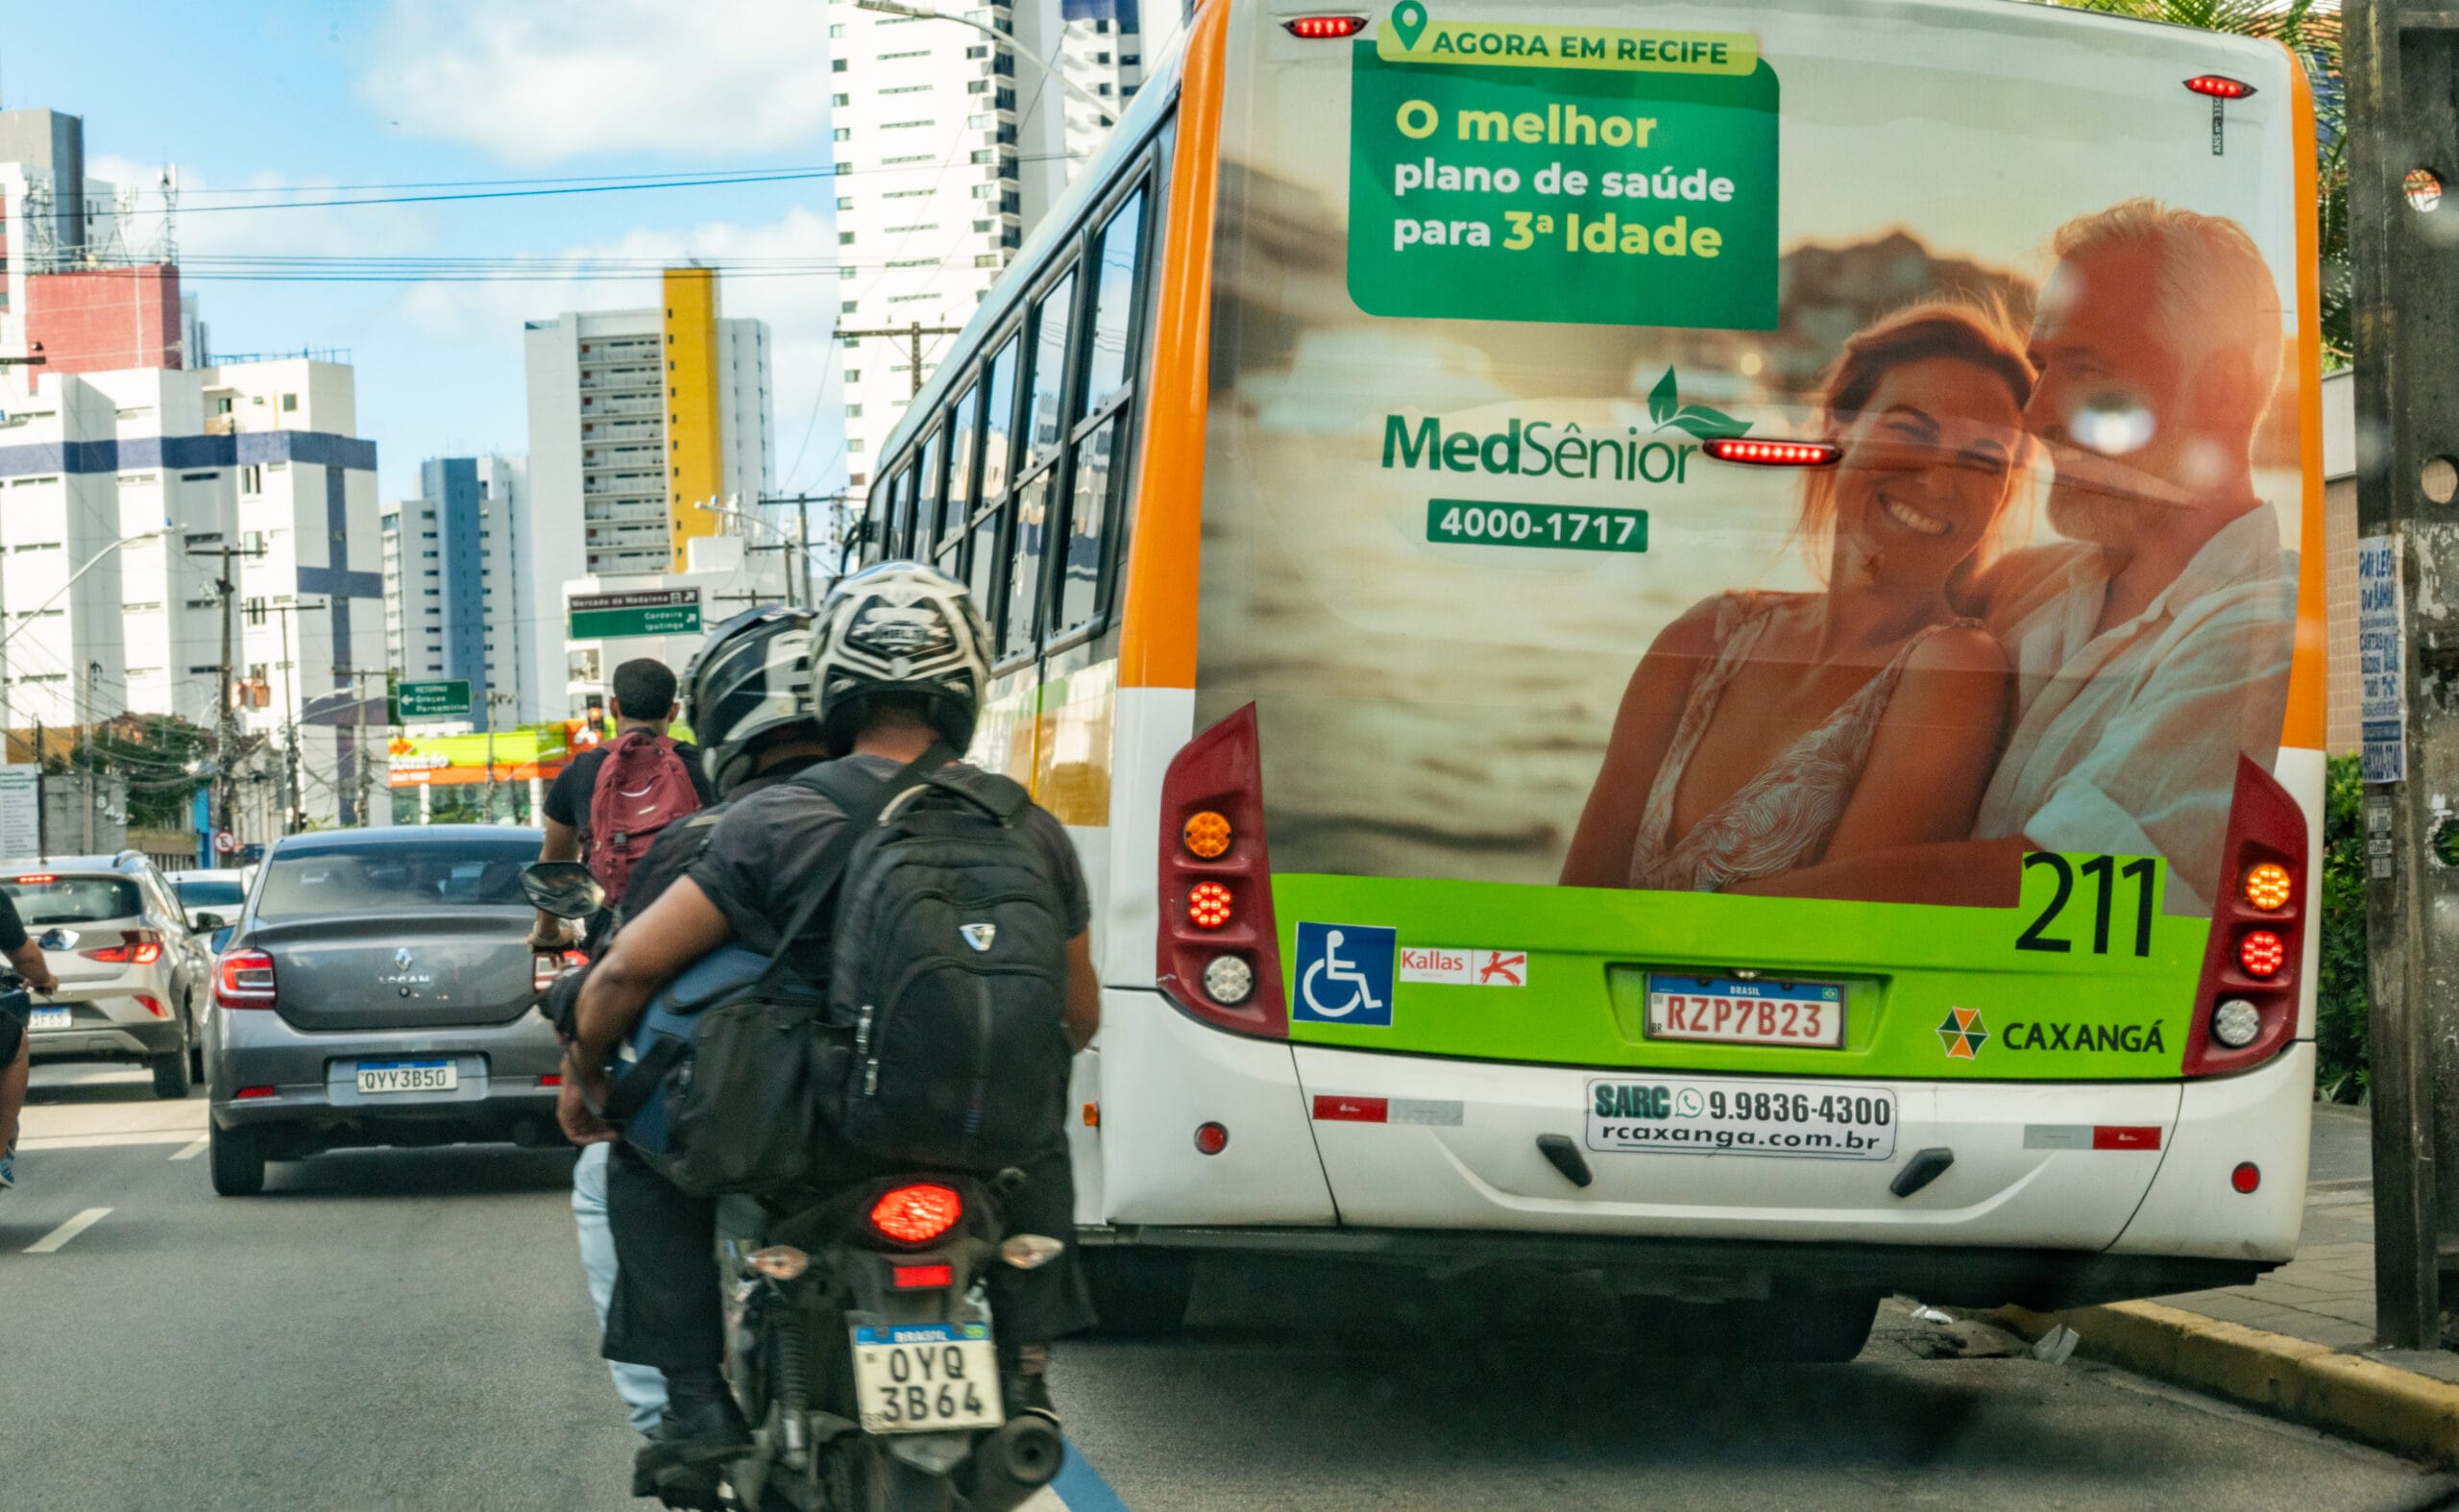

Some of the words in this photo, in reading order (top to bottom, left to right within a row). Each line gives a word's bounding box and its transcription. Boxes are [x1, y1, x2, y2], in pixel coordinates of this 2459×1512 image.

[1431, 31, 1550, 58] AGORA
[1560, 37, 1605, 60] EM
[1617, 38, 1728, 64] RECIFE
[1396, 99, 1439, 139] O
[1457, 104, 1657, 148] melhor
[1394, 157, 1521, 197] plano
[1533, 161, 1588, 195] de
[1601, 165, 1735, 203] saúde
[1393, 217, 1491, 252] para
[1566, 212, 1722, 258] Idade
[1381, 413, 1699, 484] MedSênior
[1440, 507, 1637, 545] 4000-1717
[612, 597, 623, 605] da
[625, 594, 669, 604] Madalena
[645, 611, 683, 621] Cordeiro
[2015, 851, 2155, 958] 211
[1401, 950, 1464, 971] Kallas
[1730, 985, 1761, 996] BRASIL
[1668, 995, 1822, 1038] RZP7B23
[2003, 1019, 2165, 1054] CAXANGÁ
[1595, 1085, 1671, 1120] SARC
[1709, 1090, 1890, 1127] 9.9836-4300
[1602, 1124, 1881, 1151] rcaxanga.com.br
[894, 1329, 949, 1342] BRASIL
[879, 1381, 983, 1422] 3B64
